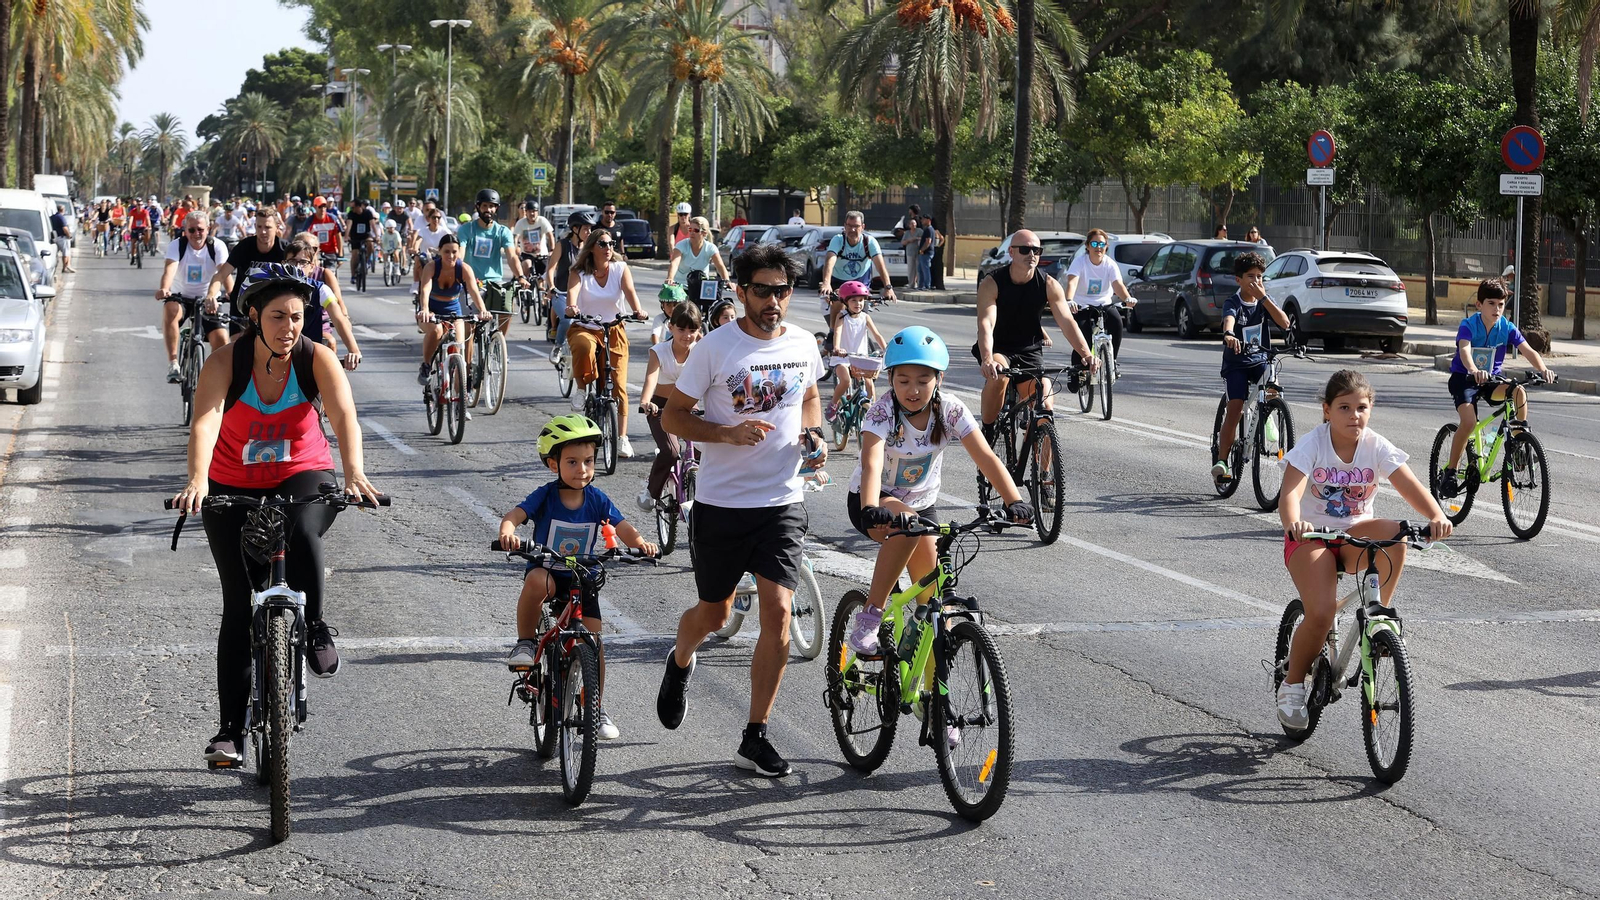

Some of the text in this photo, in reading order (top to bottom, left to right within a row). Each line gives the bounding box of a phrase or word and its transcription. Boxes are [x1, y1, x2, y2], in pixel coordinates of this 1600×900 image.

[750, 361, 808, 372] CARRERA POPULAR
[1313, 466, 1375, 485] OHANA
